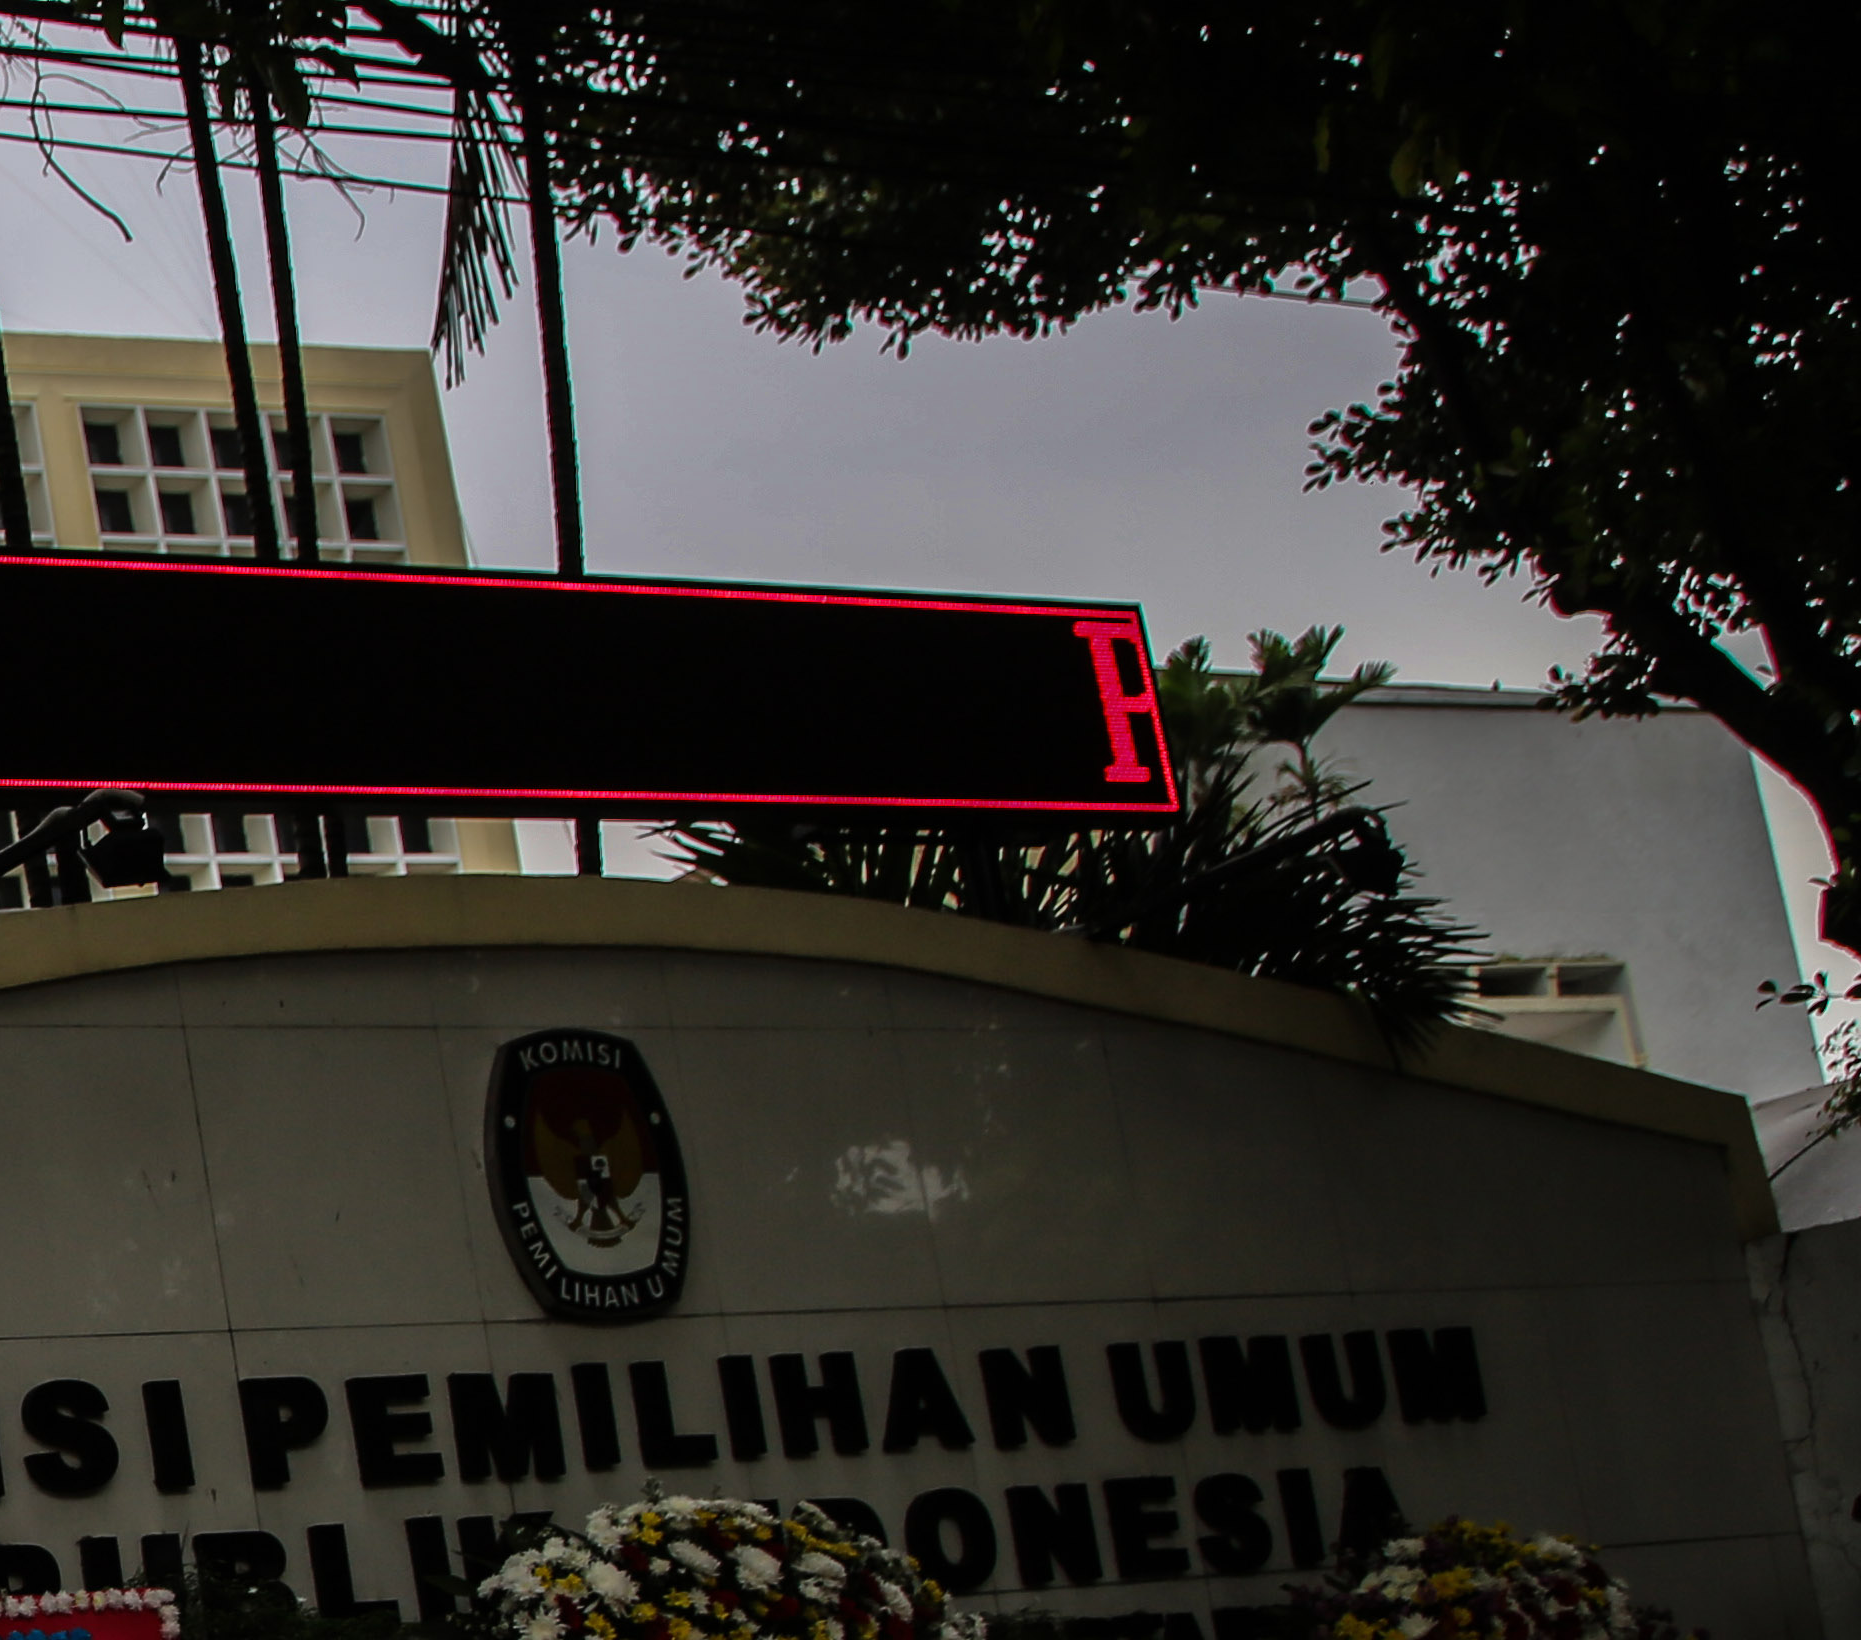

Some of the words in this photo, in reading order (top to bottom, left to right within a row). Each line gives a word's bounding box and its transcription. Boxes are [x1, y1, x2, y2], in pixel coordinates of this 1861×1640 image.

[518, 1041, 621, 1073] KOMISI
[511, 1201, 640, 1308] PEMILIHAN
[646, 1197, 684, 1299] UMUM
[237, 1344, 1077, 1490] PEMILIHAN
[1107, 1325, 1488, 1443] UMUM
